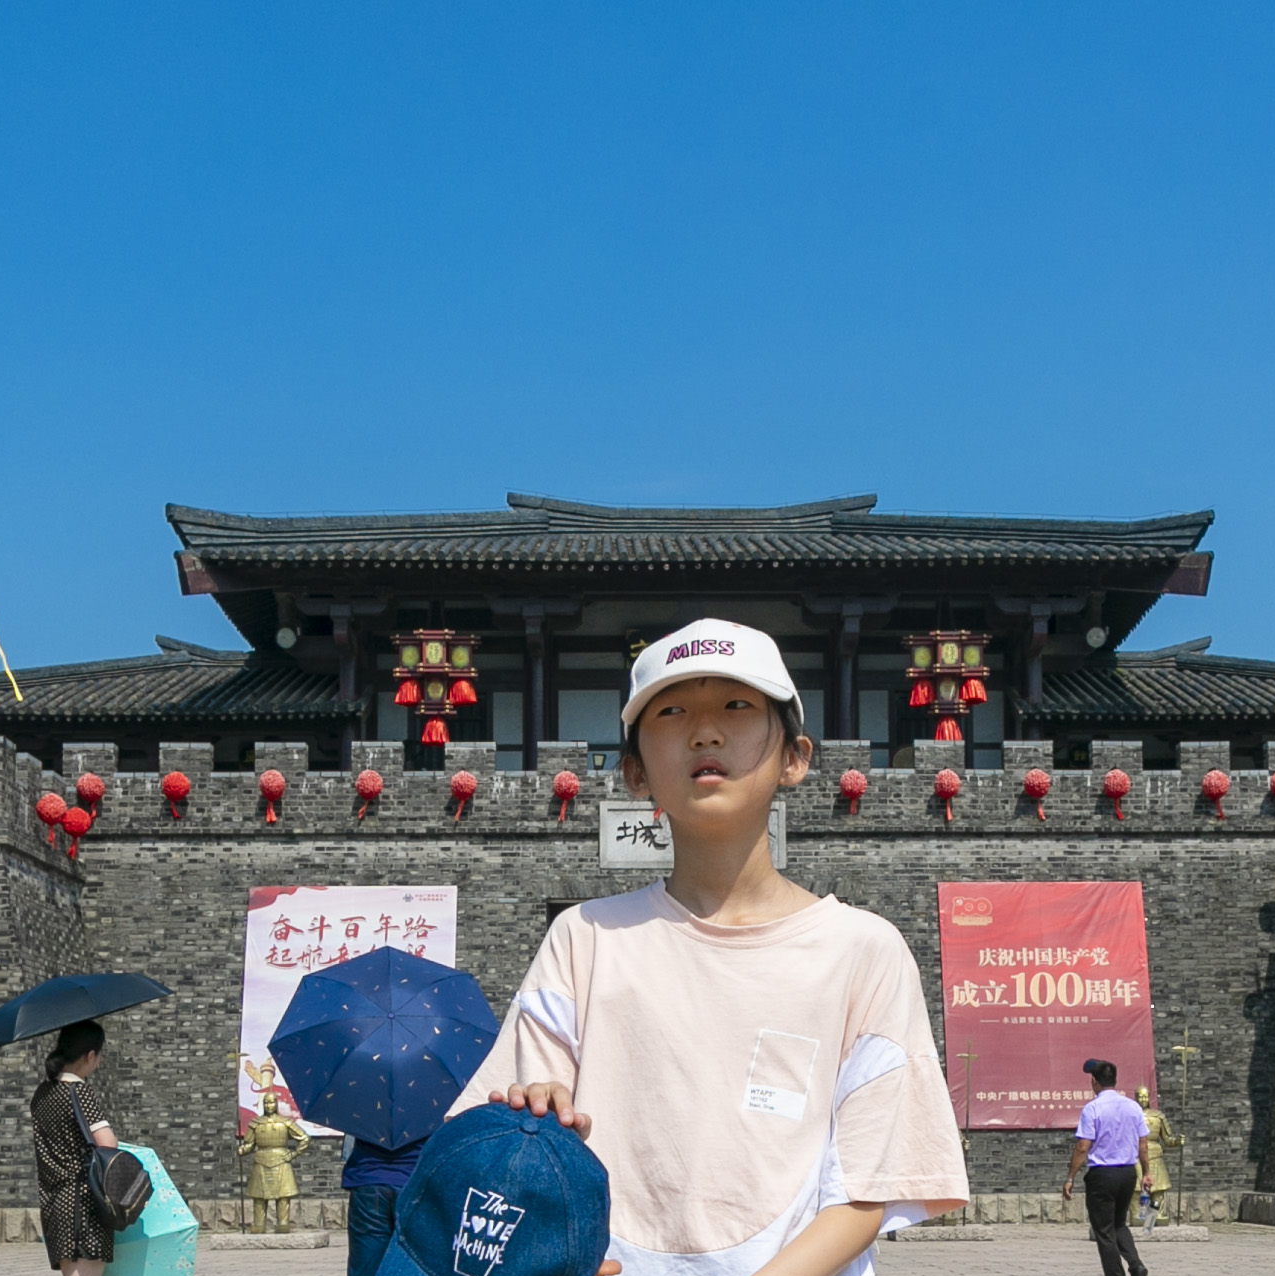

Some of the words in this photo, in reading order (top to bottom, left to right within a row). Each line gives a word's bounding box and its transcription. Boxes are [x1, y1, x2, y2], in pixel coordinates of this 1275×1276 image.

[665, 640, 735, 665] MISS
[269, 913, 438, 944] 奋斗百年路
[265, 942, 427, 971] 起航新
[978, 947, 1110, 967] 庆祝中国共产党
[951, 971, 1141, 1008] 成立100周年
[976, 1089, 1127, 1102] 中央广播电视总台无锡影
[480, 1191, 508, 1216] The
[452, 1232, 504, 1264] MACHINE
